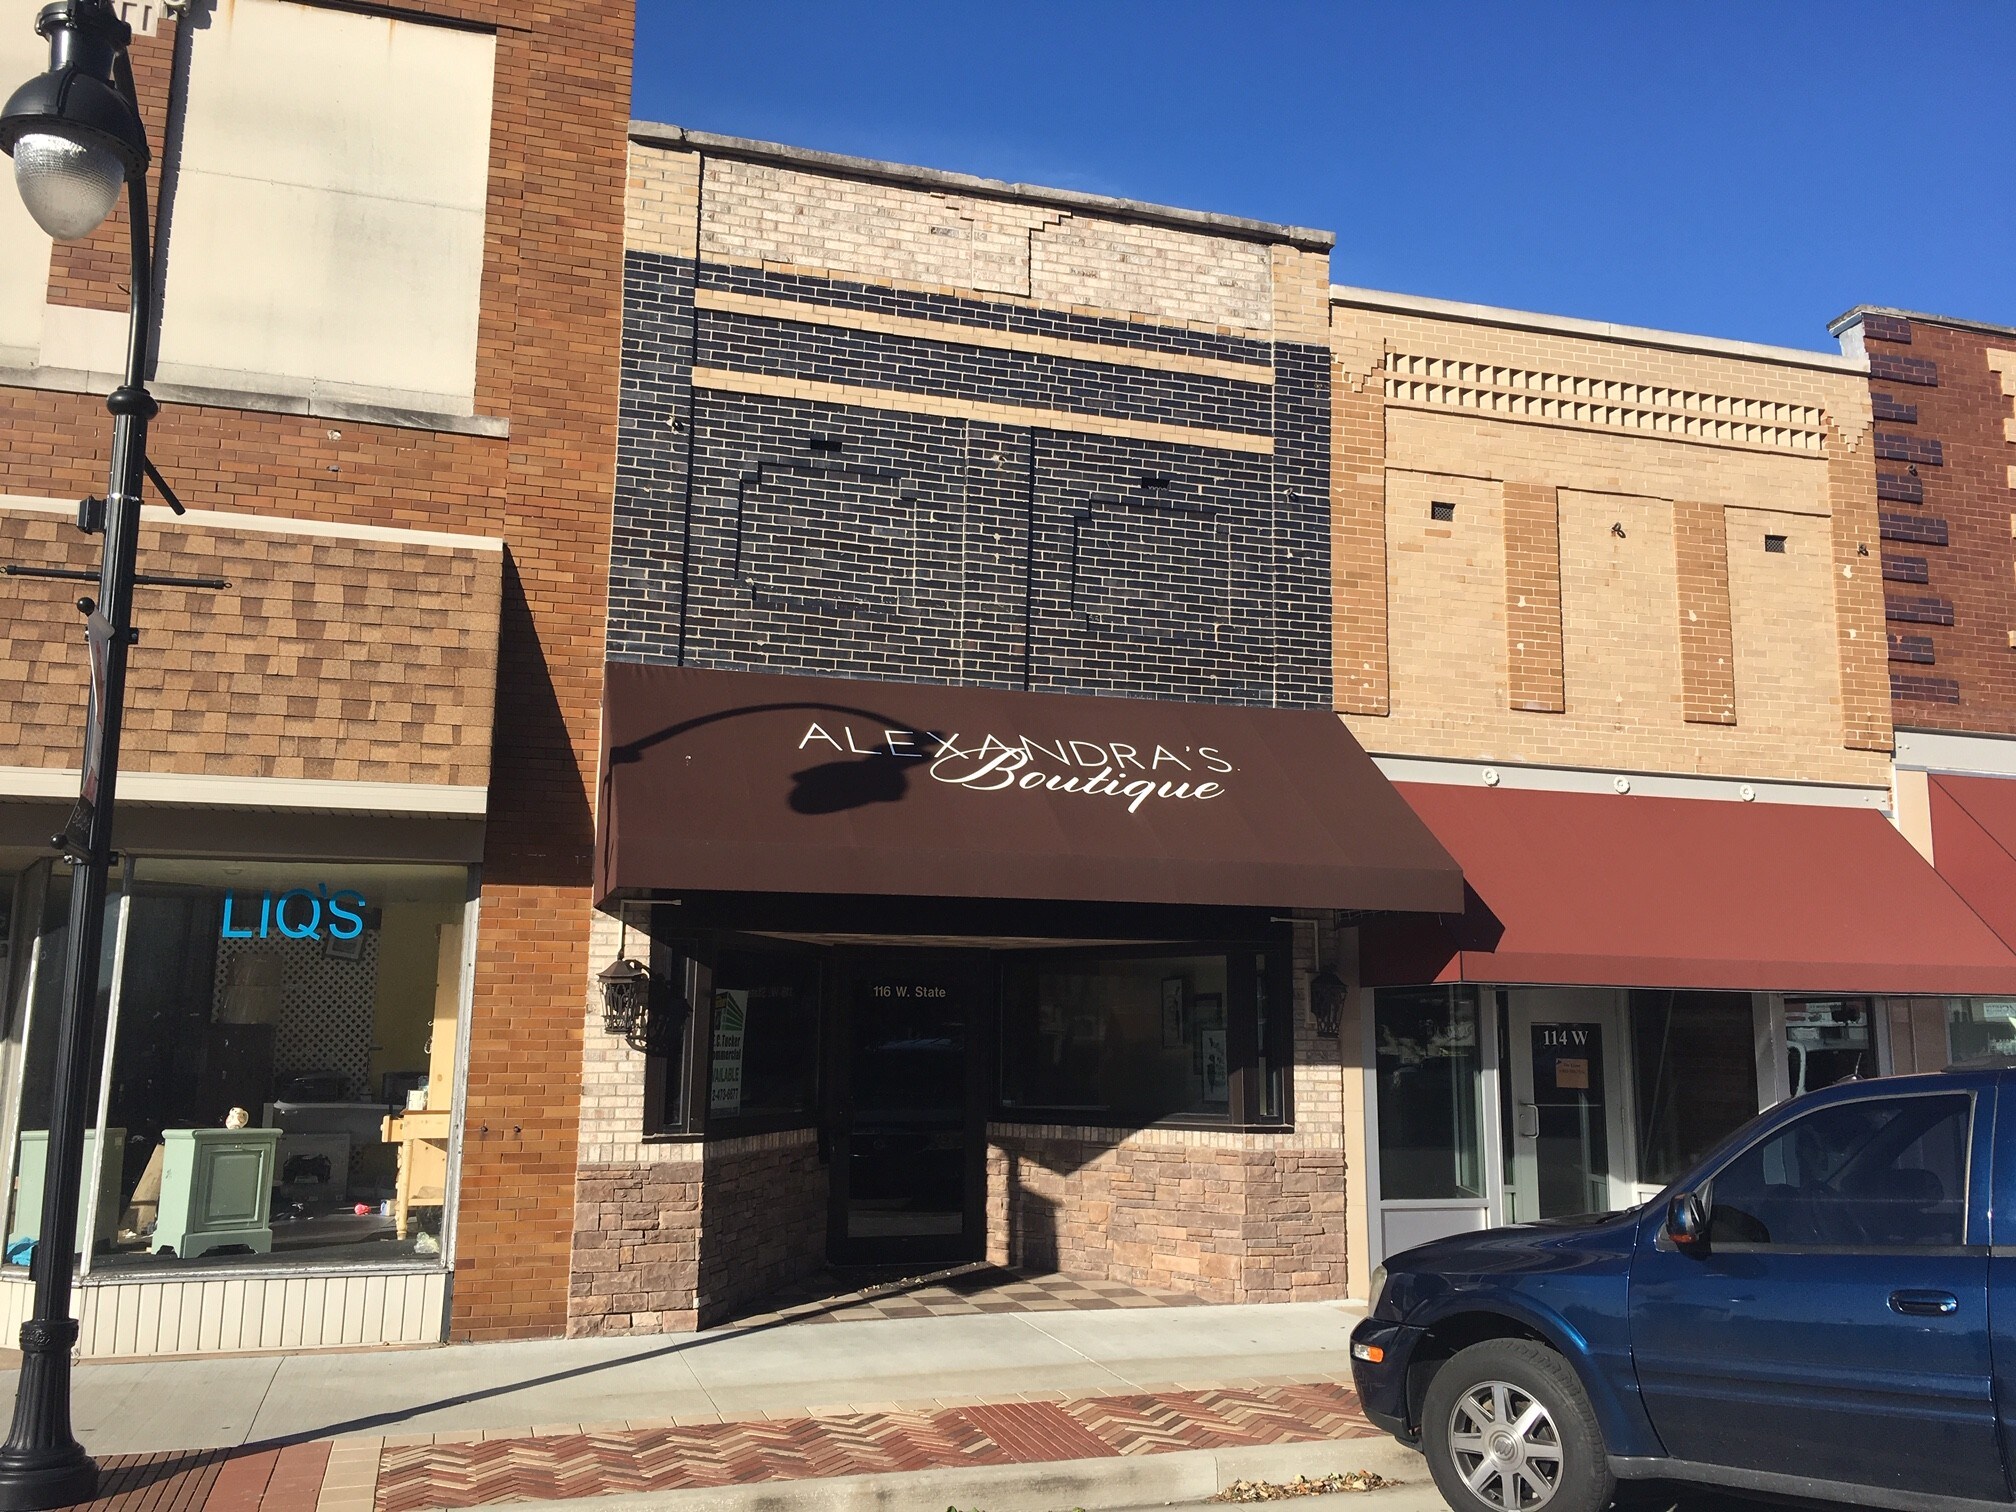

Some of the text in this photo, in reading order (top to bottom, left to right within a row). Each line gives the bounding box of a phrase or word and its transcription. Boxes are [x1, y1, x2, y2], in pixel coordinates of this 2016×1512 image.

[929, 746, 1226, 814] Boutique
[222, 882, 366, 941] LIQ'S
[873, 985, 947, 998] 116 W. State
[1543, 1030, 1589, 1046] 114 W
[713, 1049, 742, 1061] ommercial
[712, 1067, 740, 1083] VAILABLE
